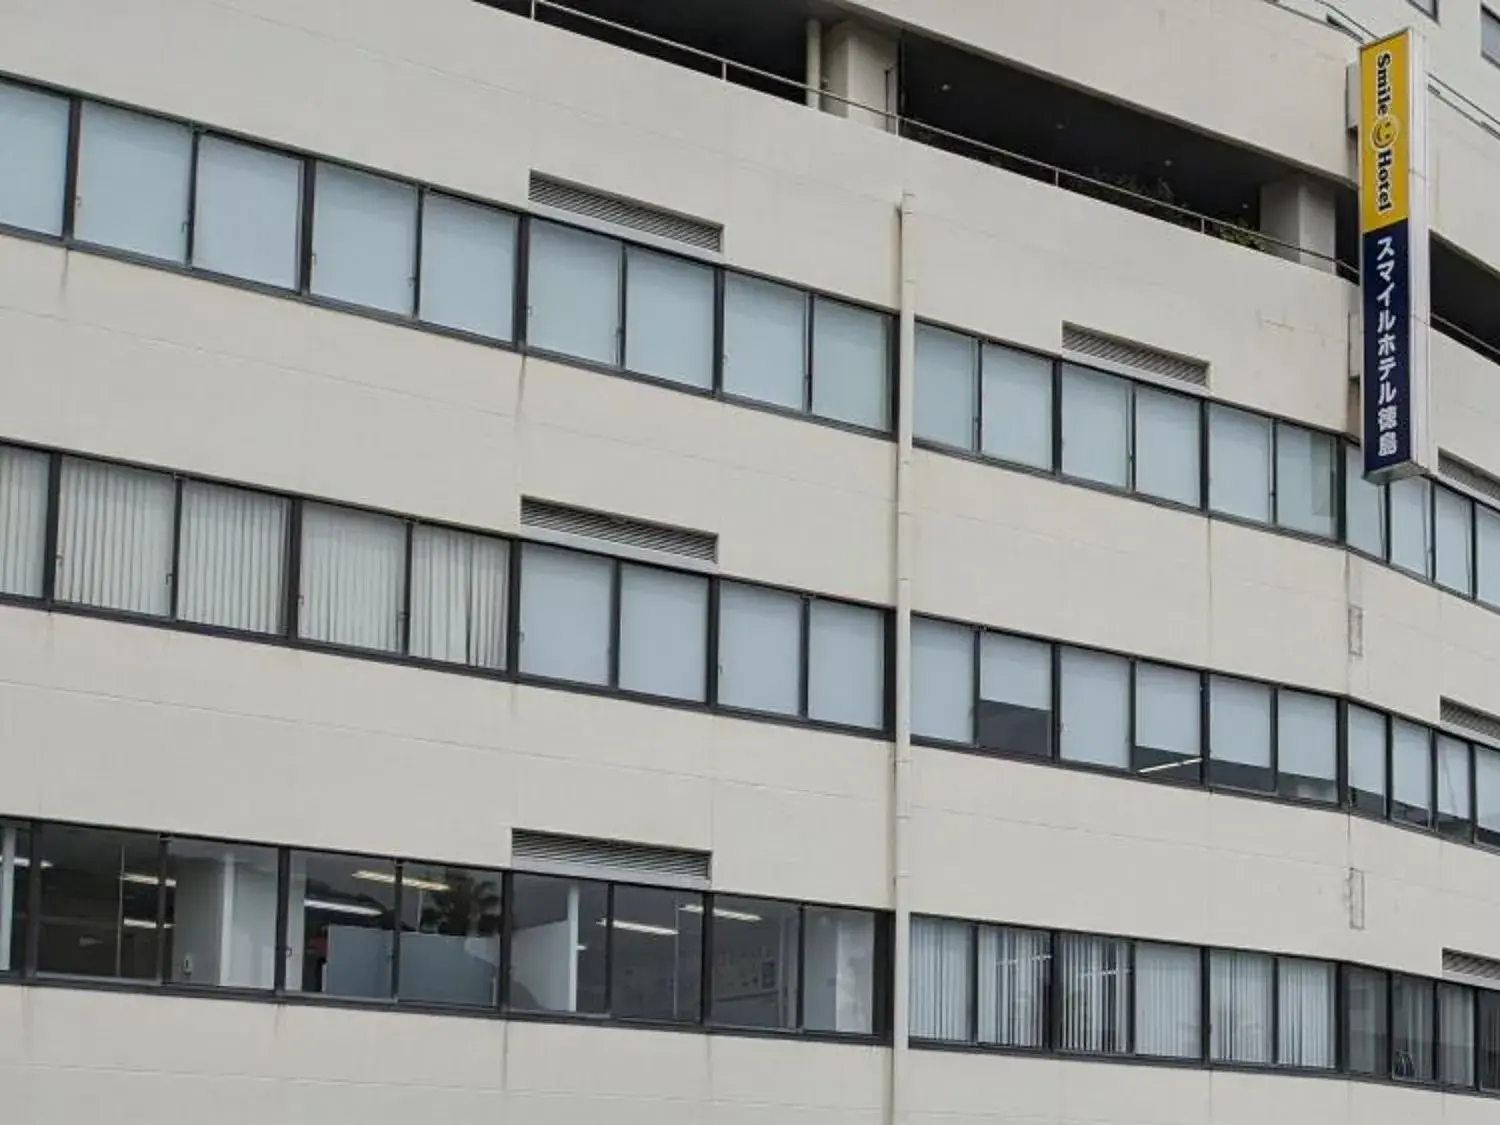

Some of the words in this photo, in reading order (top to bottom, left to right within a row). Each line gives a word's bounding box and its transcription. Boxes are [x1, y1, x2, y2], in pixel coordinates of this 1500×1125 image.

[1377, 52, 1392, 116] Smile
[1377, 149, 1393, 212] Hotel
[1376, 235, 1398, 457] スマイルホテル徳島
